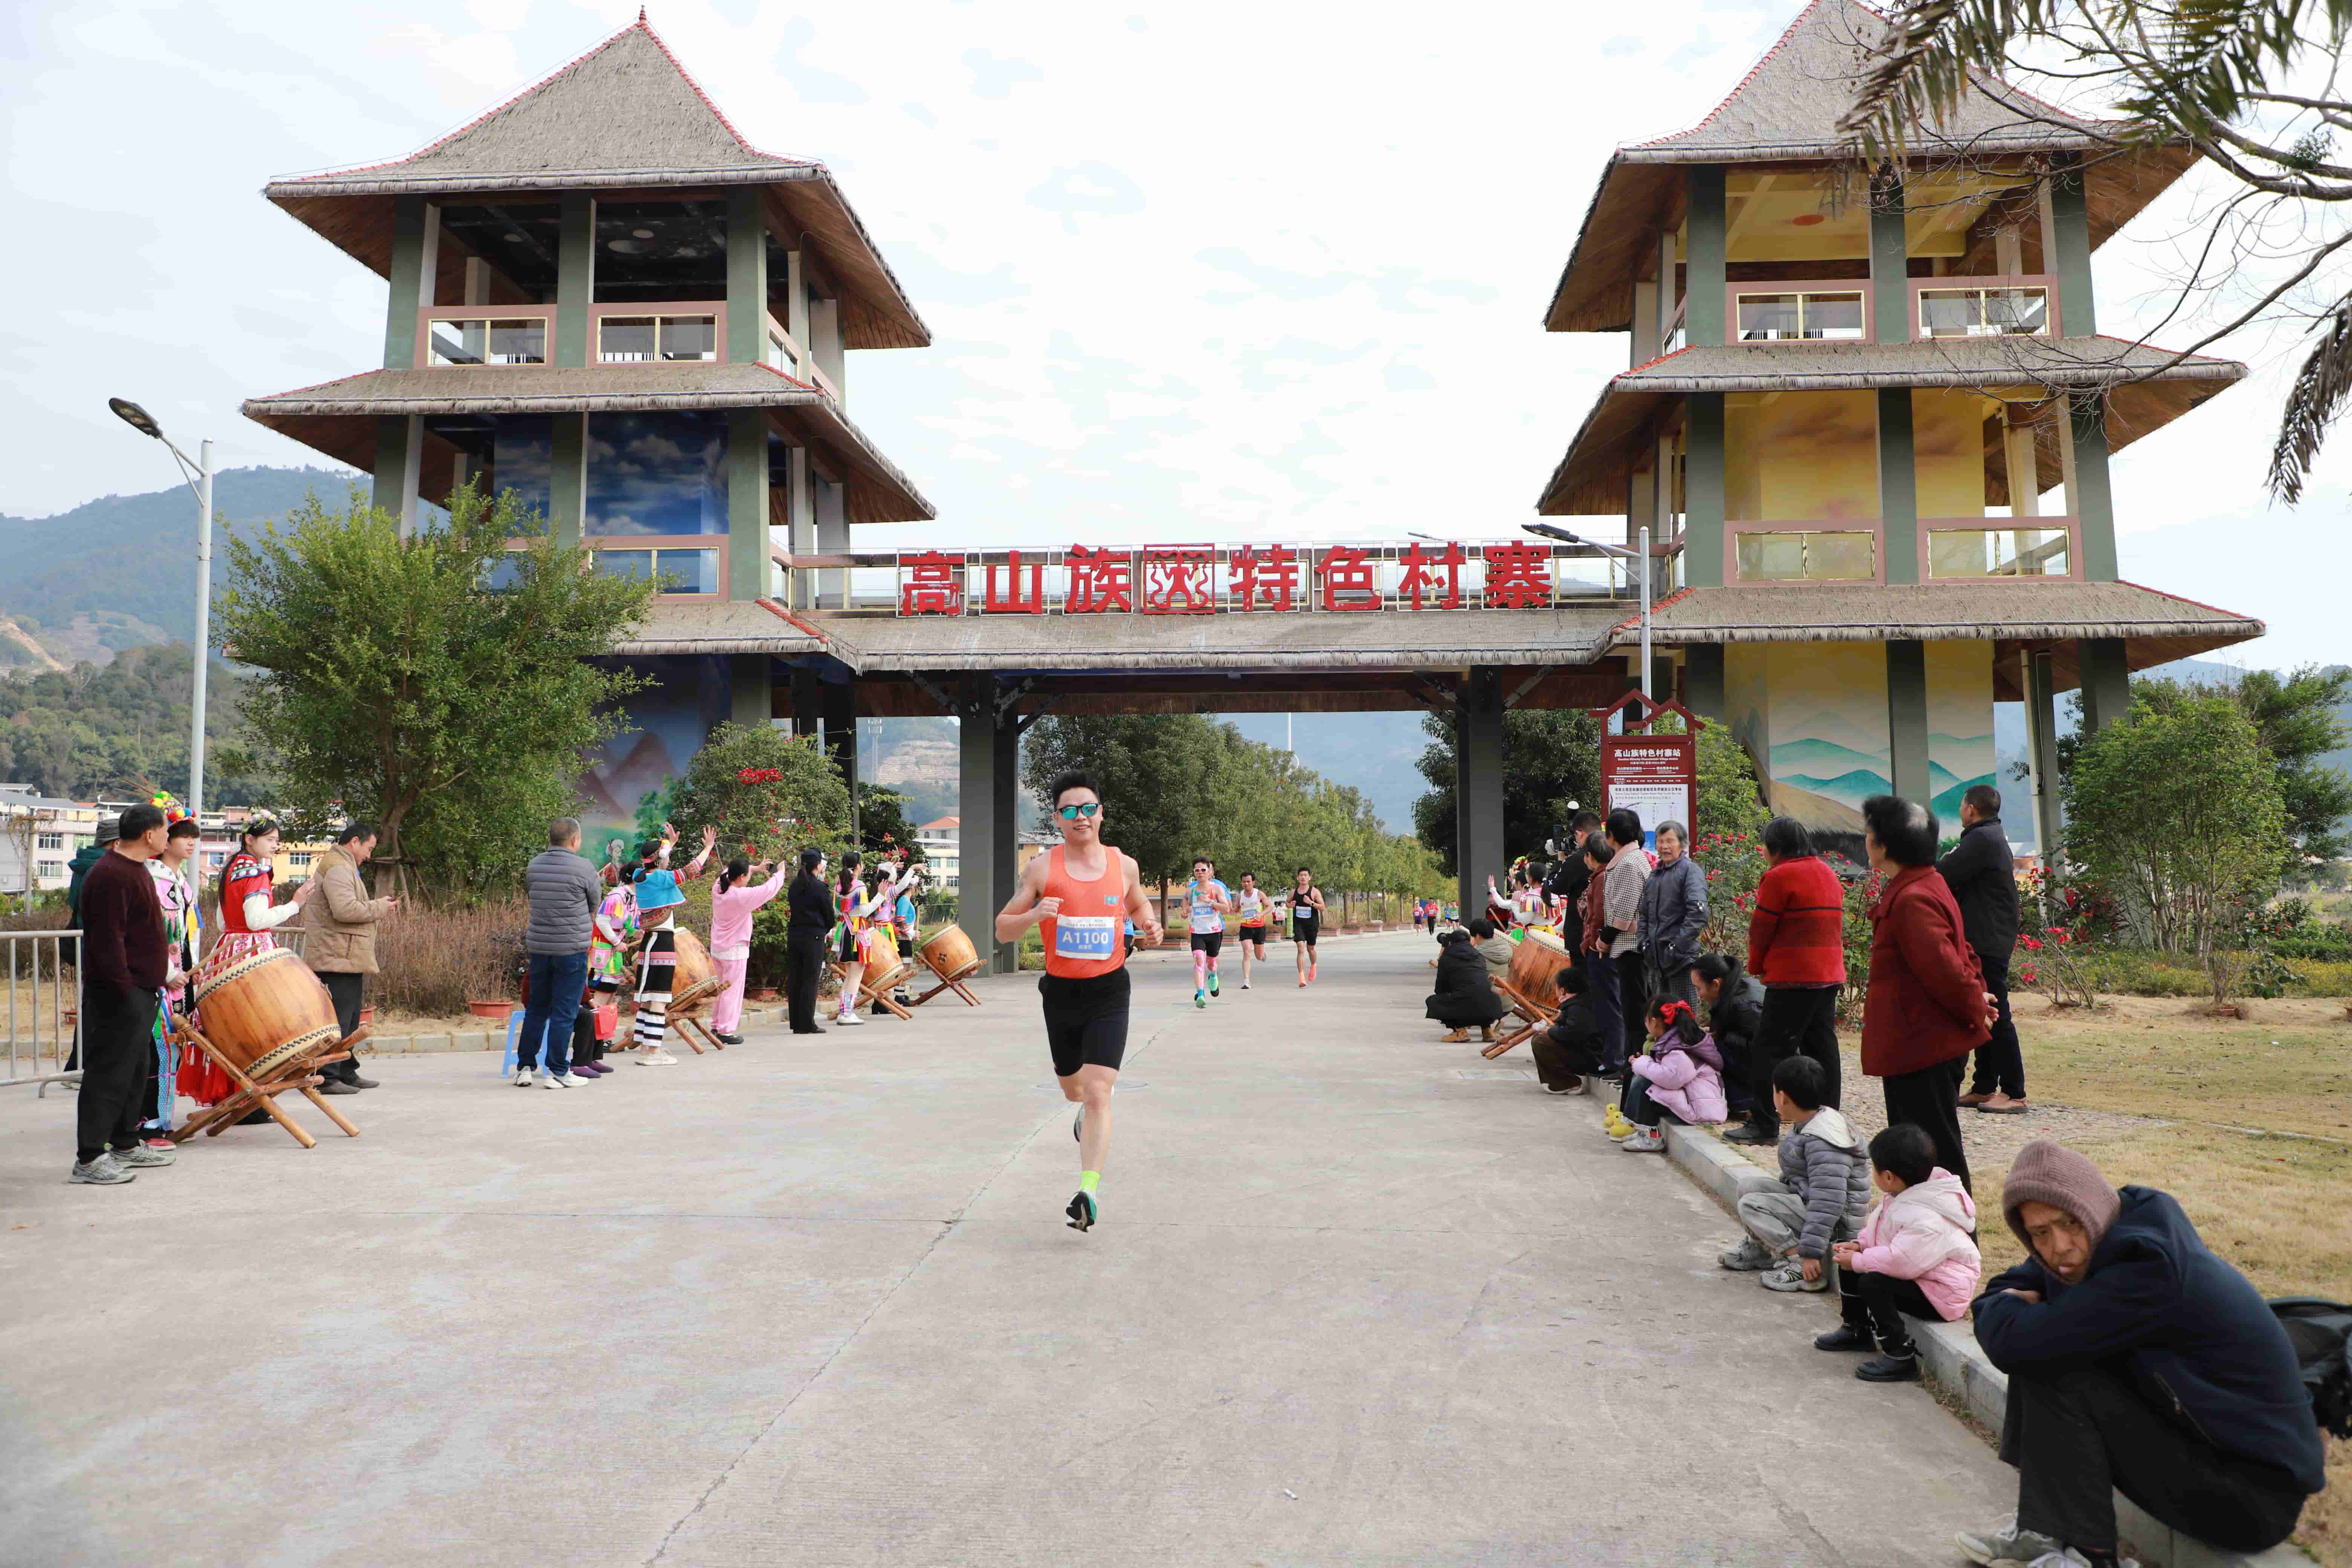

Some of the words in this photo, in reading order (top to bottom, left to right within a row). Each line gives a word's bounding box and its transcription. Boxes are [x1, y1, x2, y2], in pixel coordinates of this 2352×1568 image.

[1614, 749, 1681, 757] 高山族特色村寨站
[1062, 931, 1109, 944] A1100
